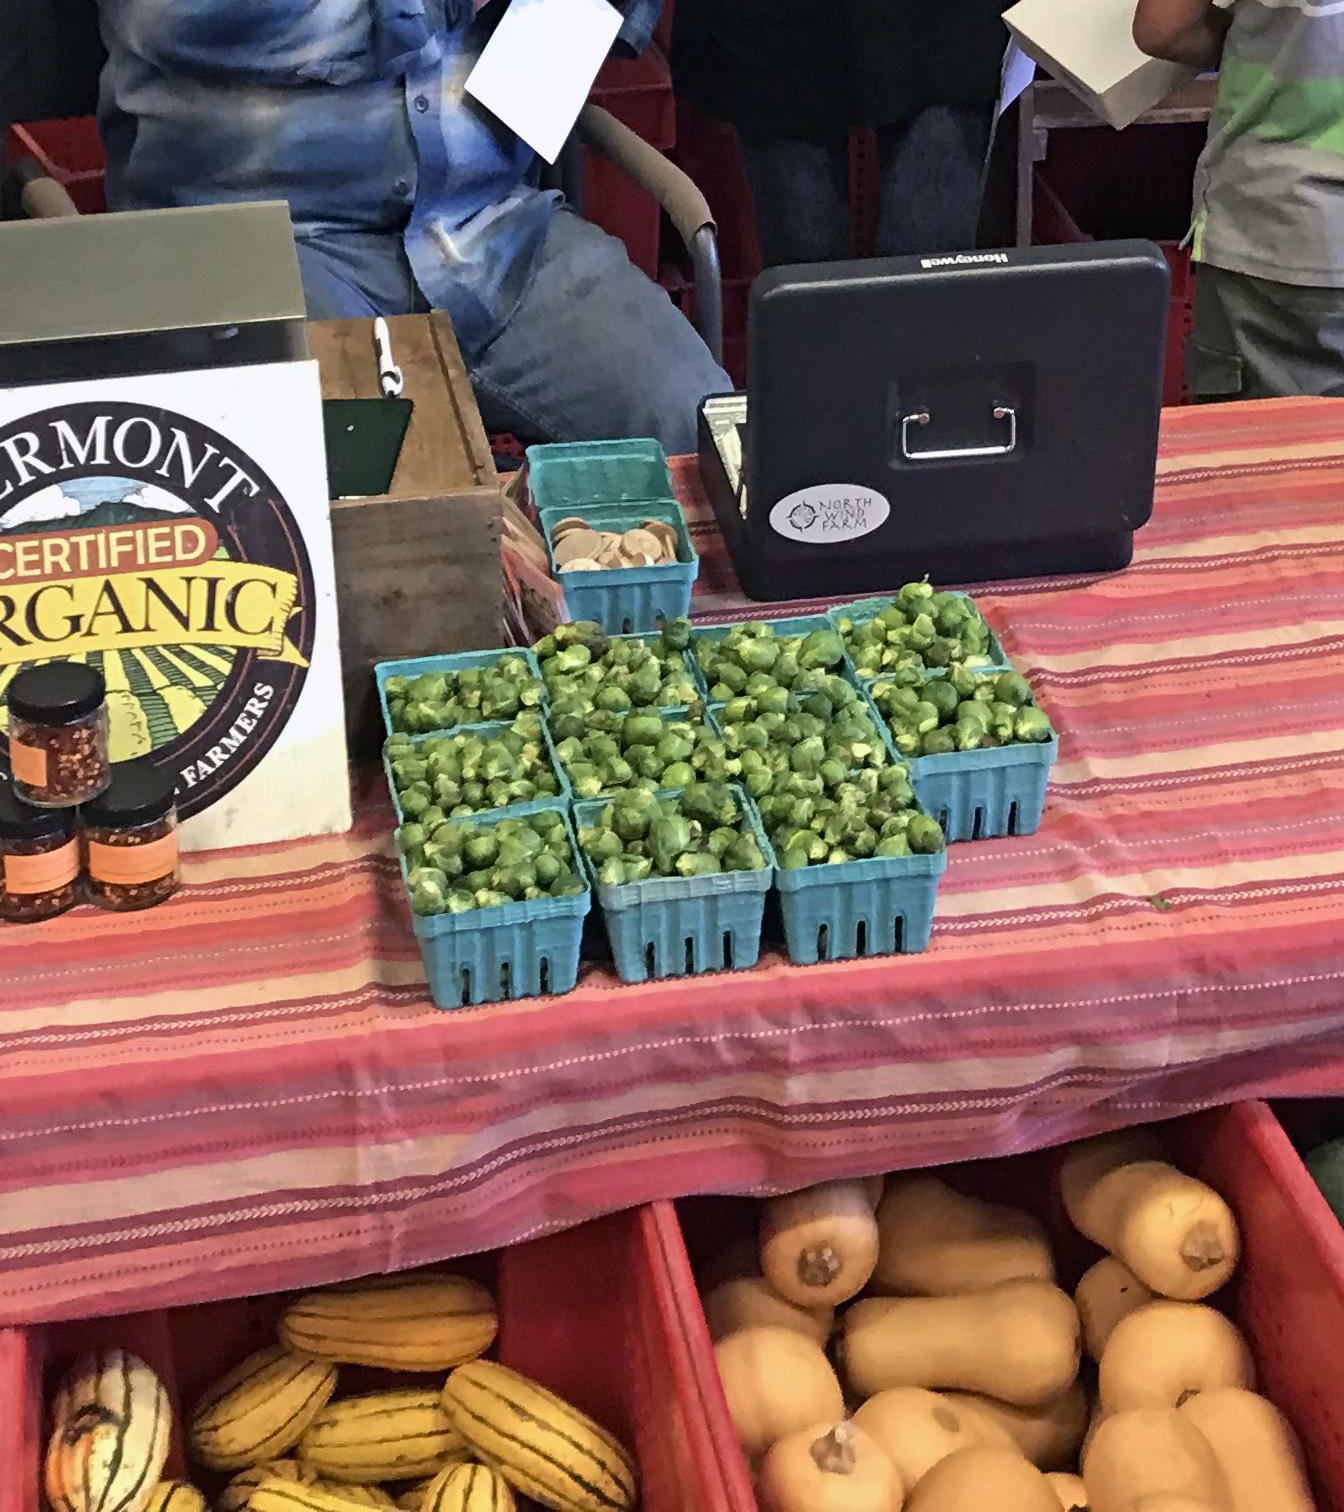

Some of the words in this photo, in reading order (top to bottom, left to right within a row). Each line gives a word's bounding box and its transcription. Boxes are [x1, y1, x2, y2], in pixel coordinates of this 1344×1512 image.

[921, 253, 1008, 268] Honeywell
[819, 498, 872, 510] NORTH
[825, 509, 865, 521] WIND
[822, 518, 867, 532] FARM
[179, 682, 274, 788] FARMERS
